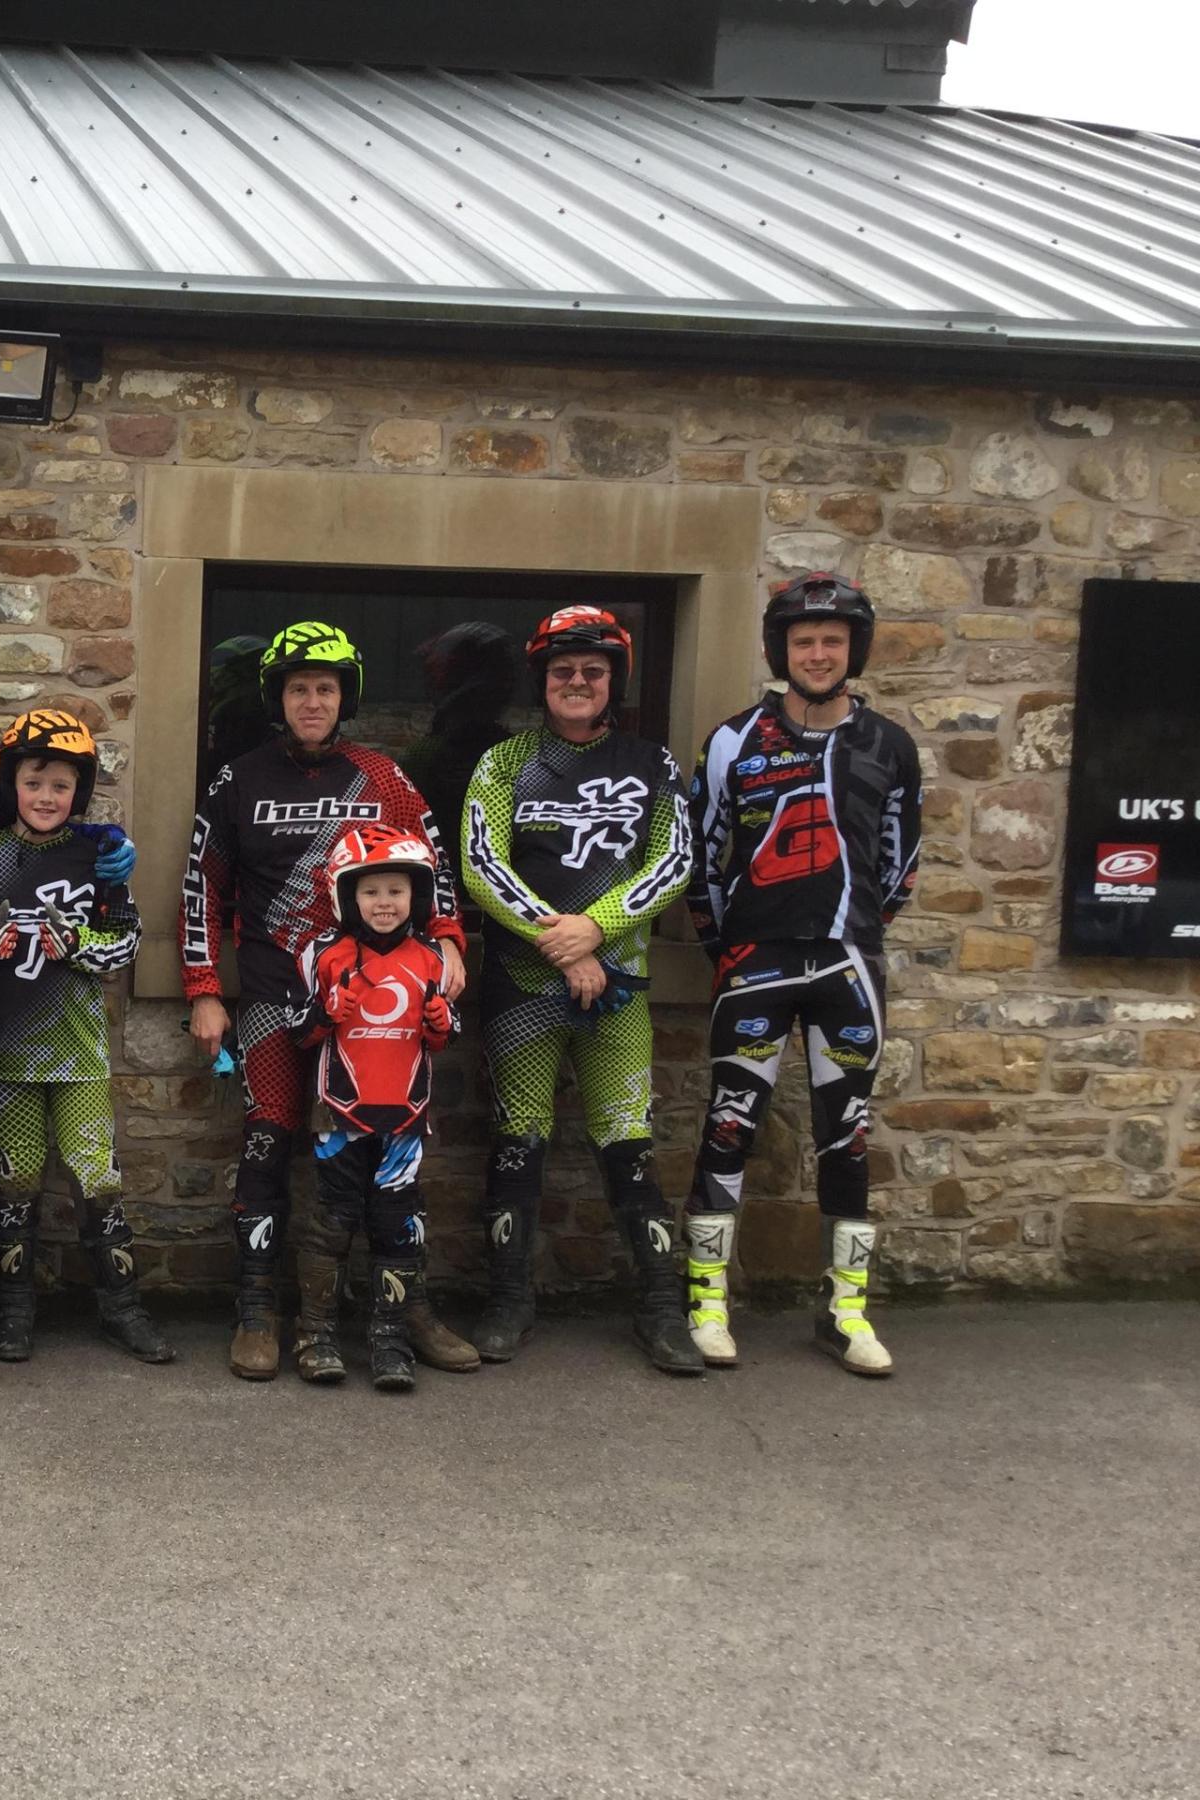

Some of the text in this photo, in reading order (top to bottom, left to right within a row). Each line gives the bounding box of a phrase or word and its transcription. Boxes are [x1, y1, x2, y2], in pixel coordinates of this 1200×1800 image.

[253, 797, 381, 824] hebo
[1118, 799, 1185, 820] UK'S
[271, 823, 323, 836] PRO
[520, 822, 561, 833] PRO
[1094, 882, 1157, 897] Beta
[346, 1026, 417, 1041] OSET
[735, 1018, 769, 1036] S3
